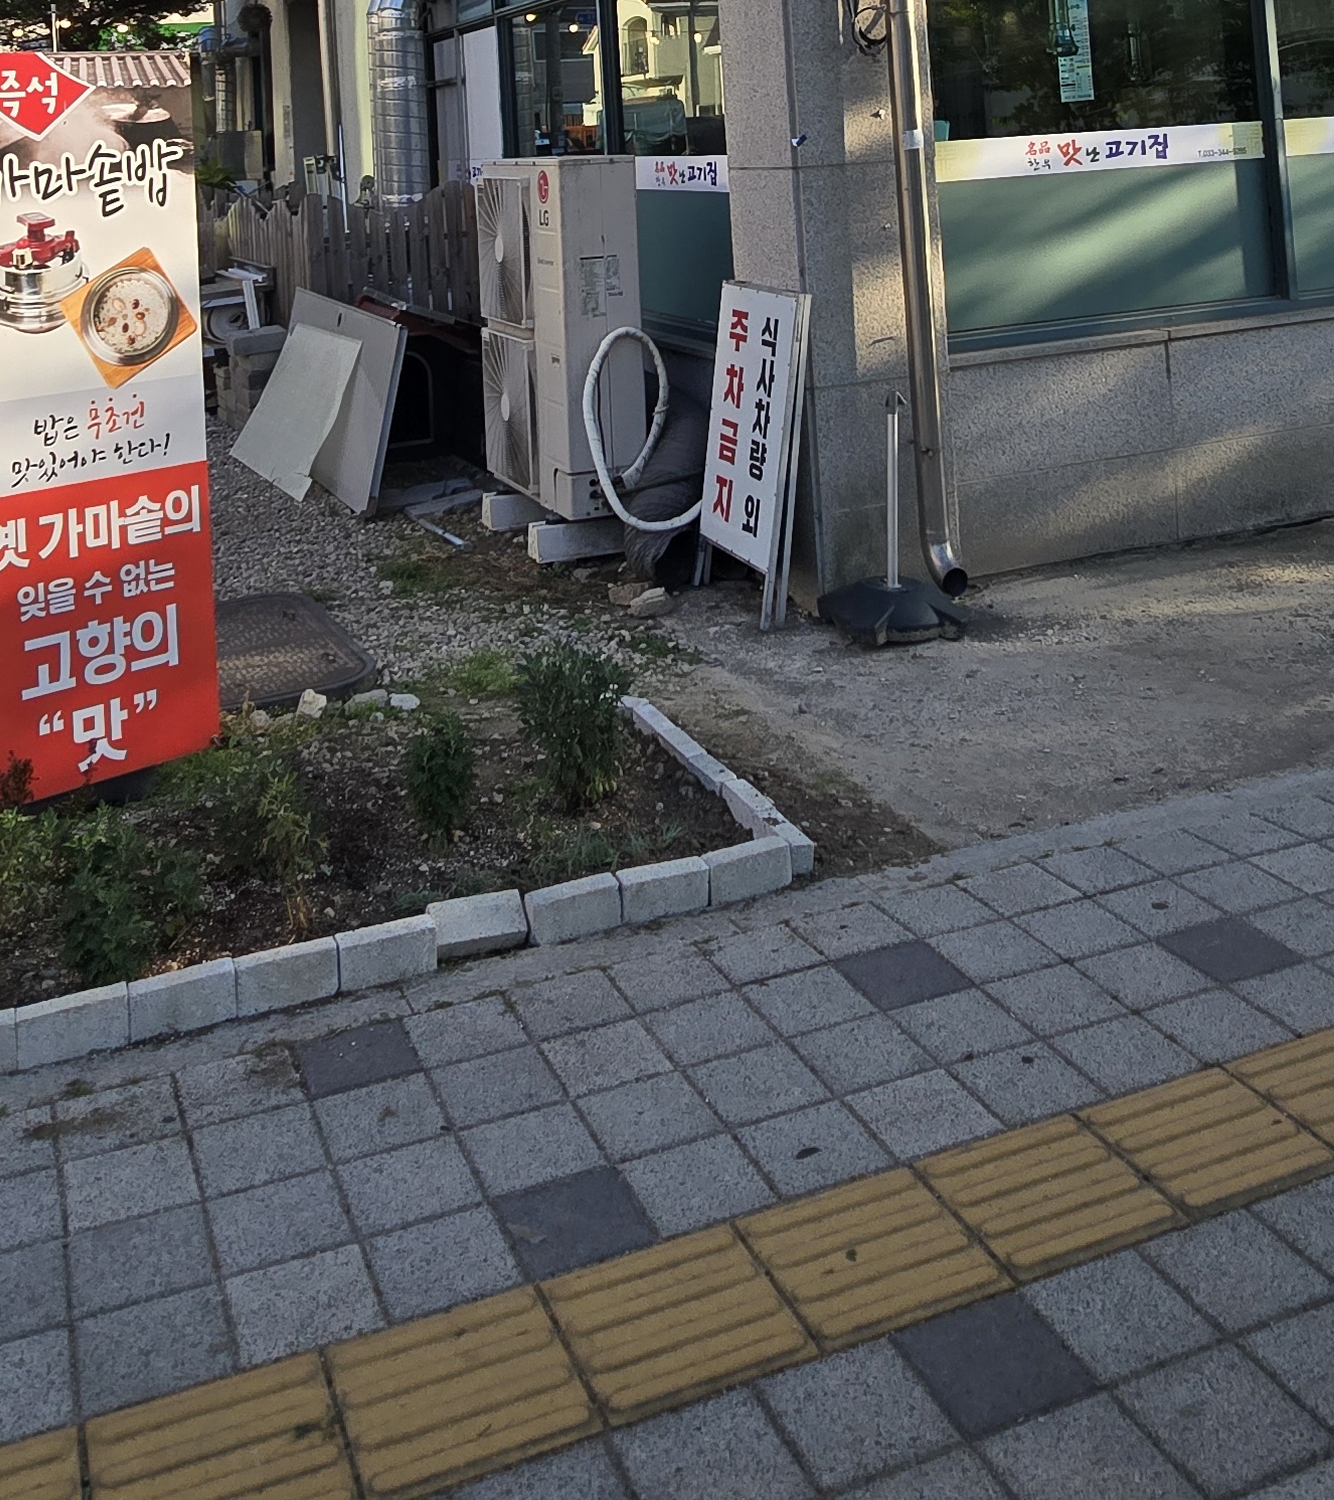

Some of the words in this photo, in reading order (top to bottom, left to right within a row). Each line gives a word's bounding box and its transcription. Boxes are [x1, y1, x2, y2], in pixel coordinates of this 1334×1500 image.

[538, 209, 549, 226] LG
[33, 412, 80, 447] 밥은
[87, 399, 146, 441] 무조건
[711, 308, 750, 524] 주차금지
[11, 447, 108, 489] 맛있어야
[113, 431, 171, 467] 한다!
[37, 484, 202, 561] 가마솥의
[741, 494, 761, 539] 외
[16, 575, 77, 623] 잊을
[83, 570, 113, 606] 수
[119, 558, 176, 598] 없는
[20, 603, 181, 702] 고향의
